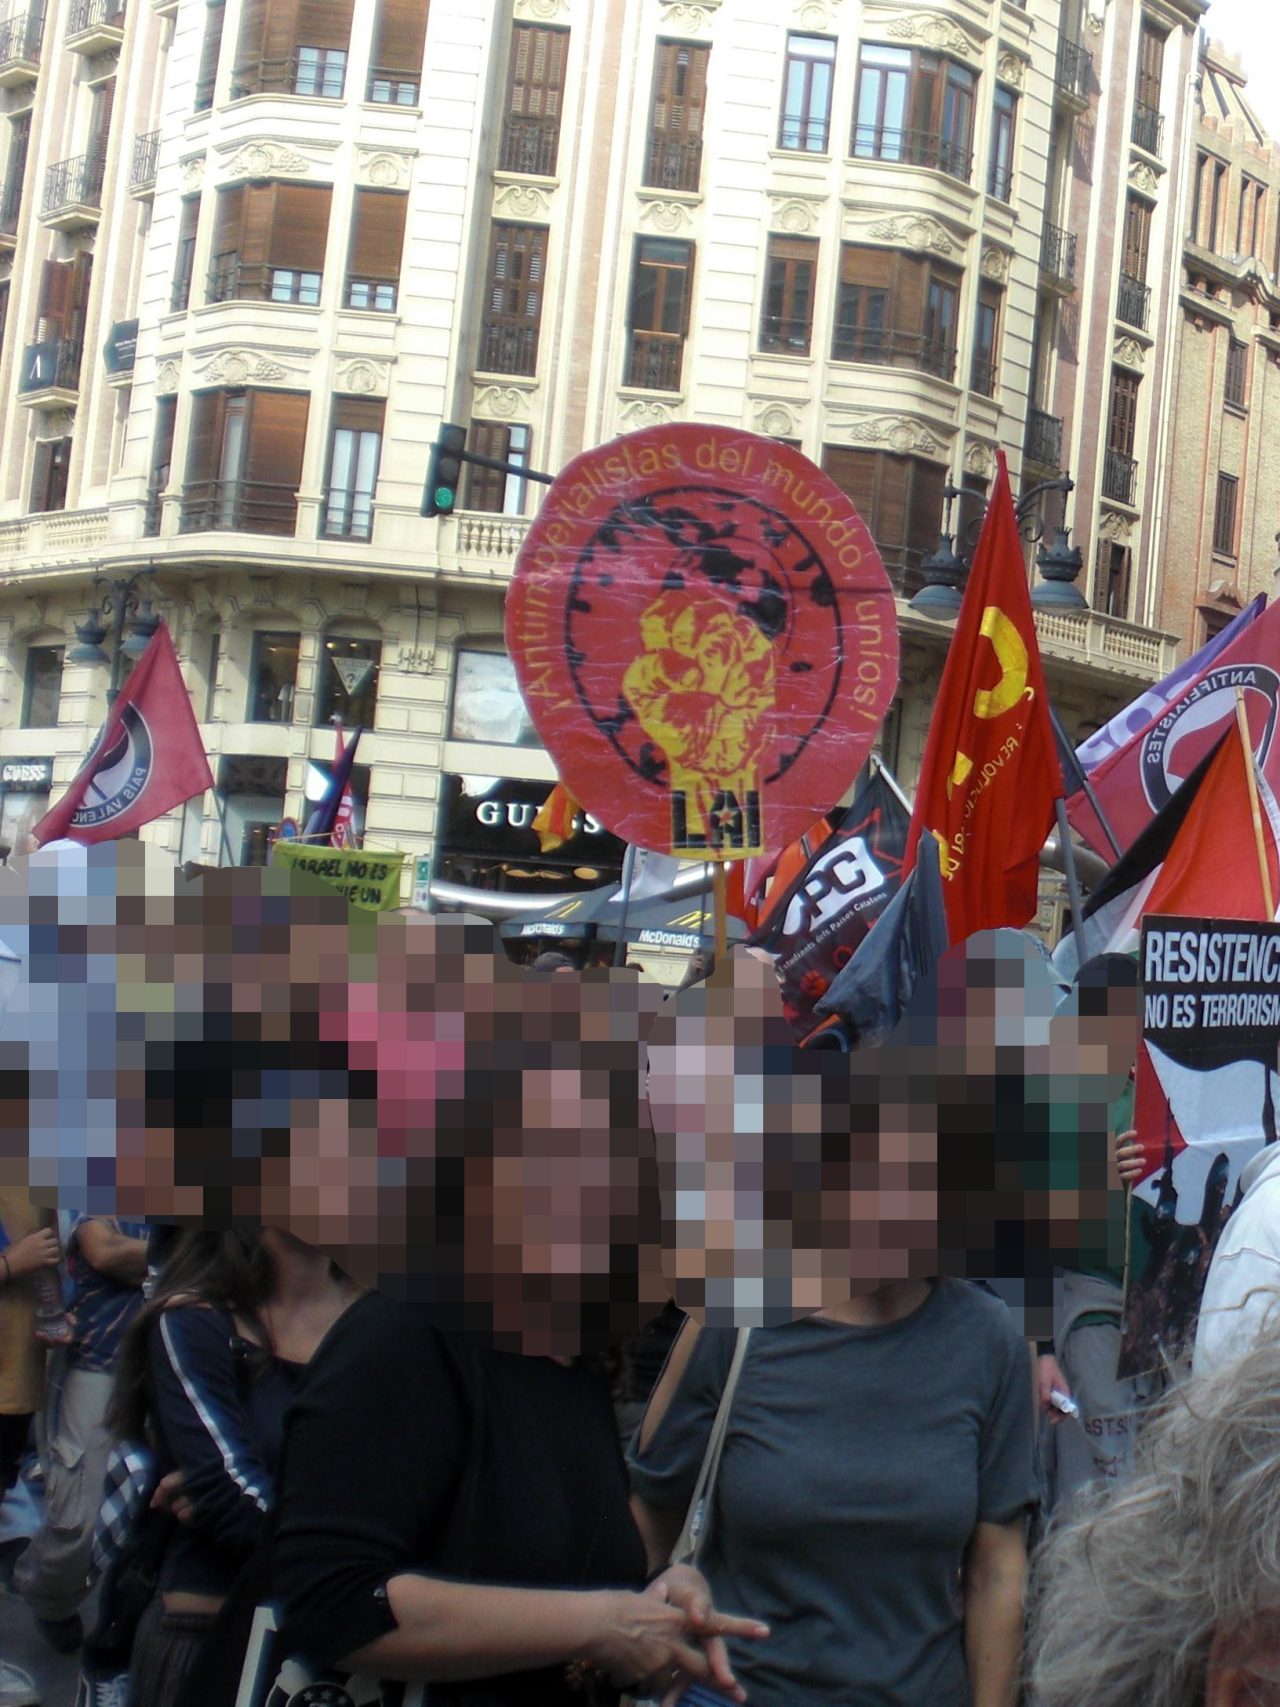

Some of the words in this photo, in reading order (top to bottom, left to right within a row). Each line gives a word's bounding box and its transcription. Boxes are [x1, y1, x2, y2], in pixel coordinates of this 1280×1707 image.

[695, 436, 753, 477] del
[475, 800, 601, 834] GUS
[672, 789, 761, 849] LAI
[638, 928, 700, 949] McDonald's
[1144, 993, 1168, 1030] NO
[1172, 993, 1196, 1029] ES
